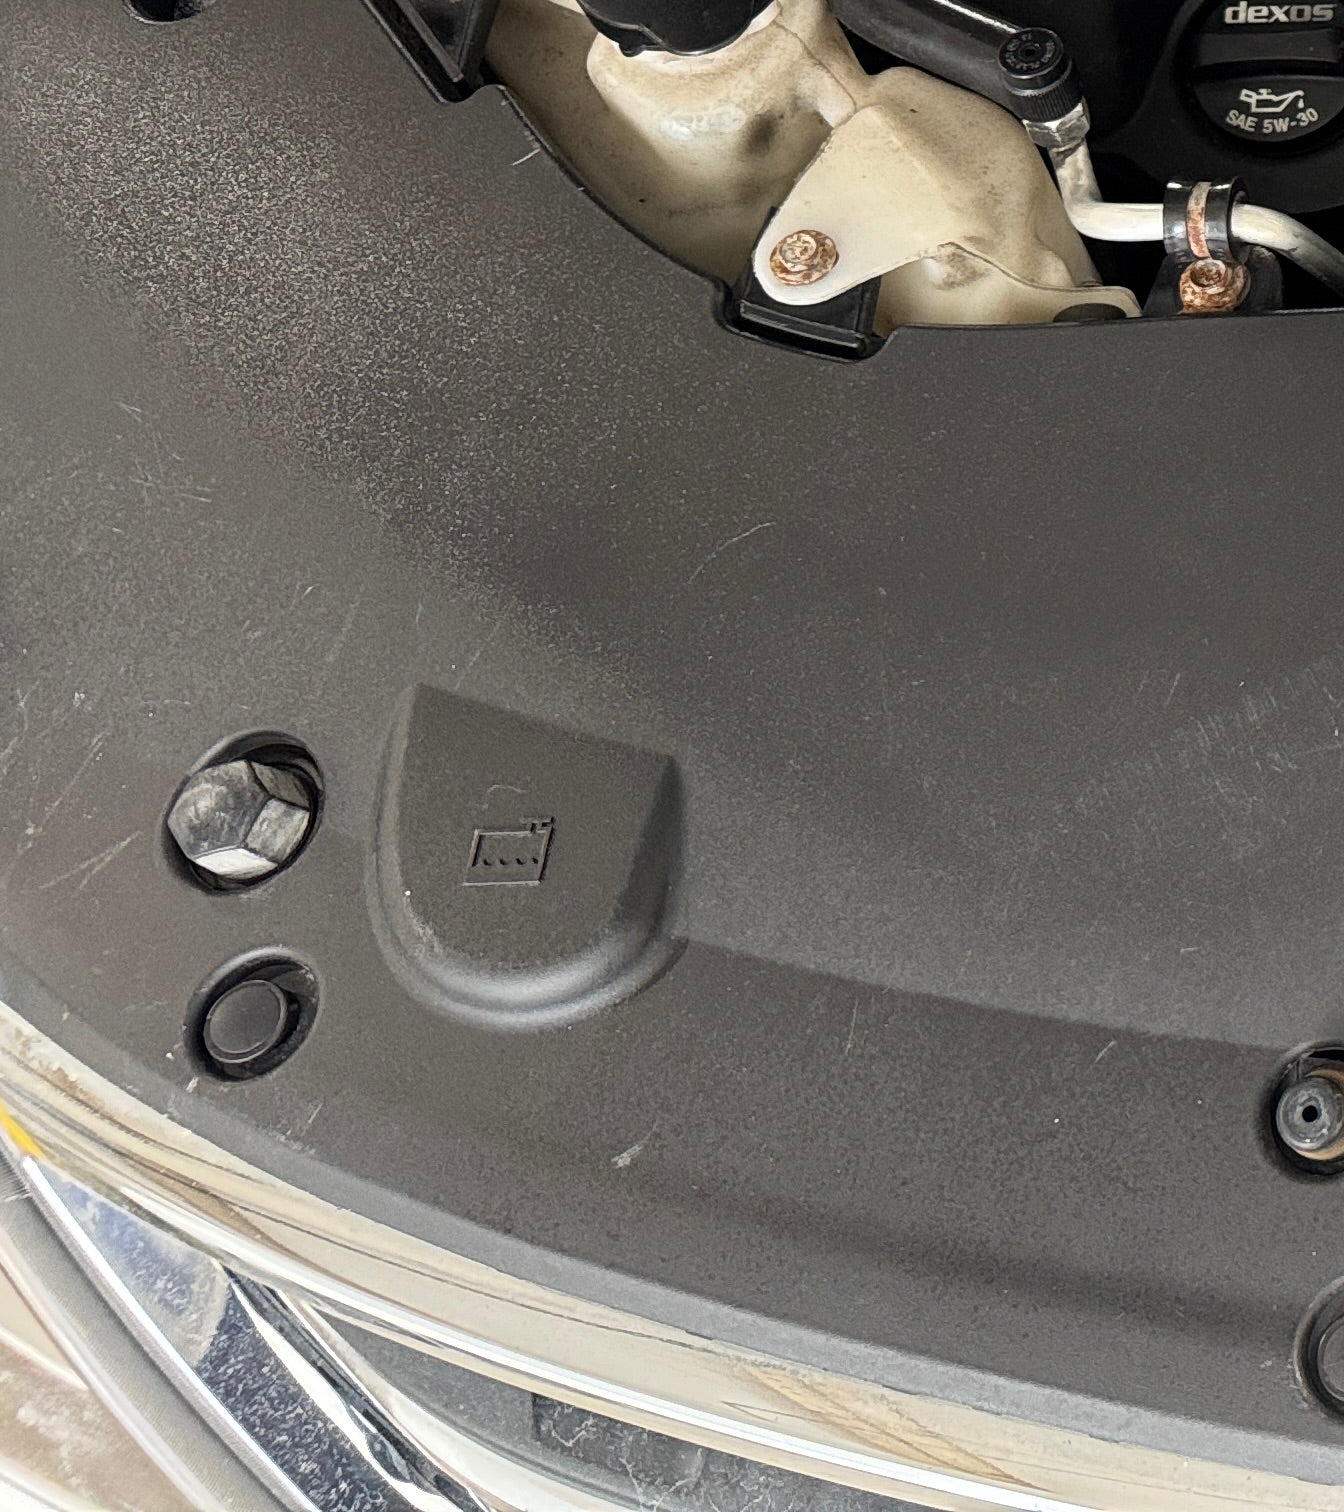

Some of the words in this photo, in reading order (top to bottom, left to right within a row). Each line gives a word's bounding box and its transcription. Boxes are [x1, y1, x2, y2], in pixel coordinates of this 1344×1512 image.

[1223, 1, 1338, 24] dexos
[1225, 110, 1258, 132] SAE
[1262, 107, 1319, 134] 5W-30
